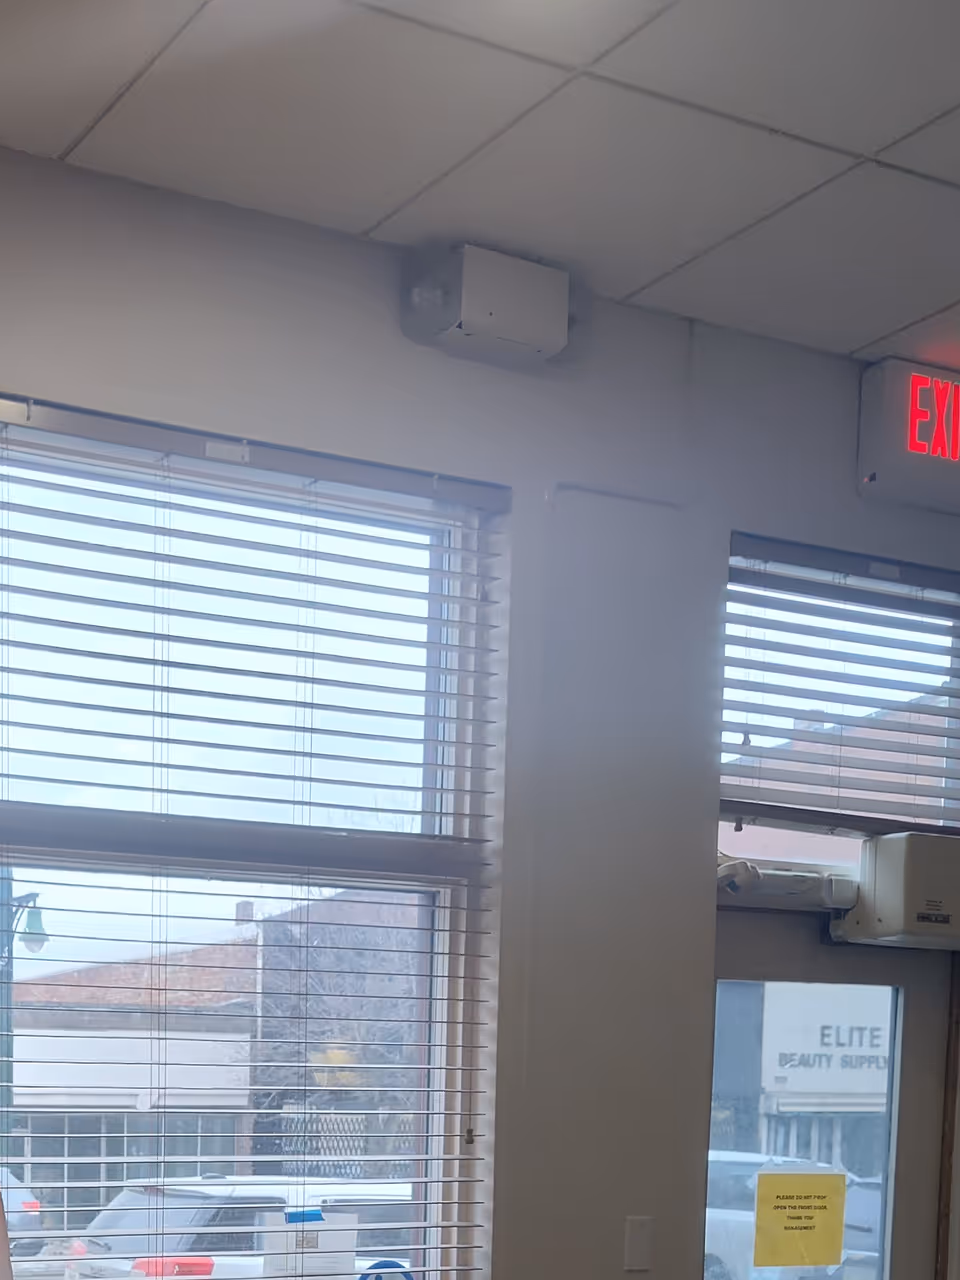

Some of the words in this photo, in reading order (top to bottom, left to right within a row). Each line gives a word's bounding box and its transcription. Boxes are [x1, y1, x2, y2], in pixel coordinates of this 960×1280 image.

[908, 373, 960, 461] EXI
[820, 1025, 882, 1048] ELITE
[778, 1053, 833, 1069] BEAUTY
